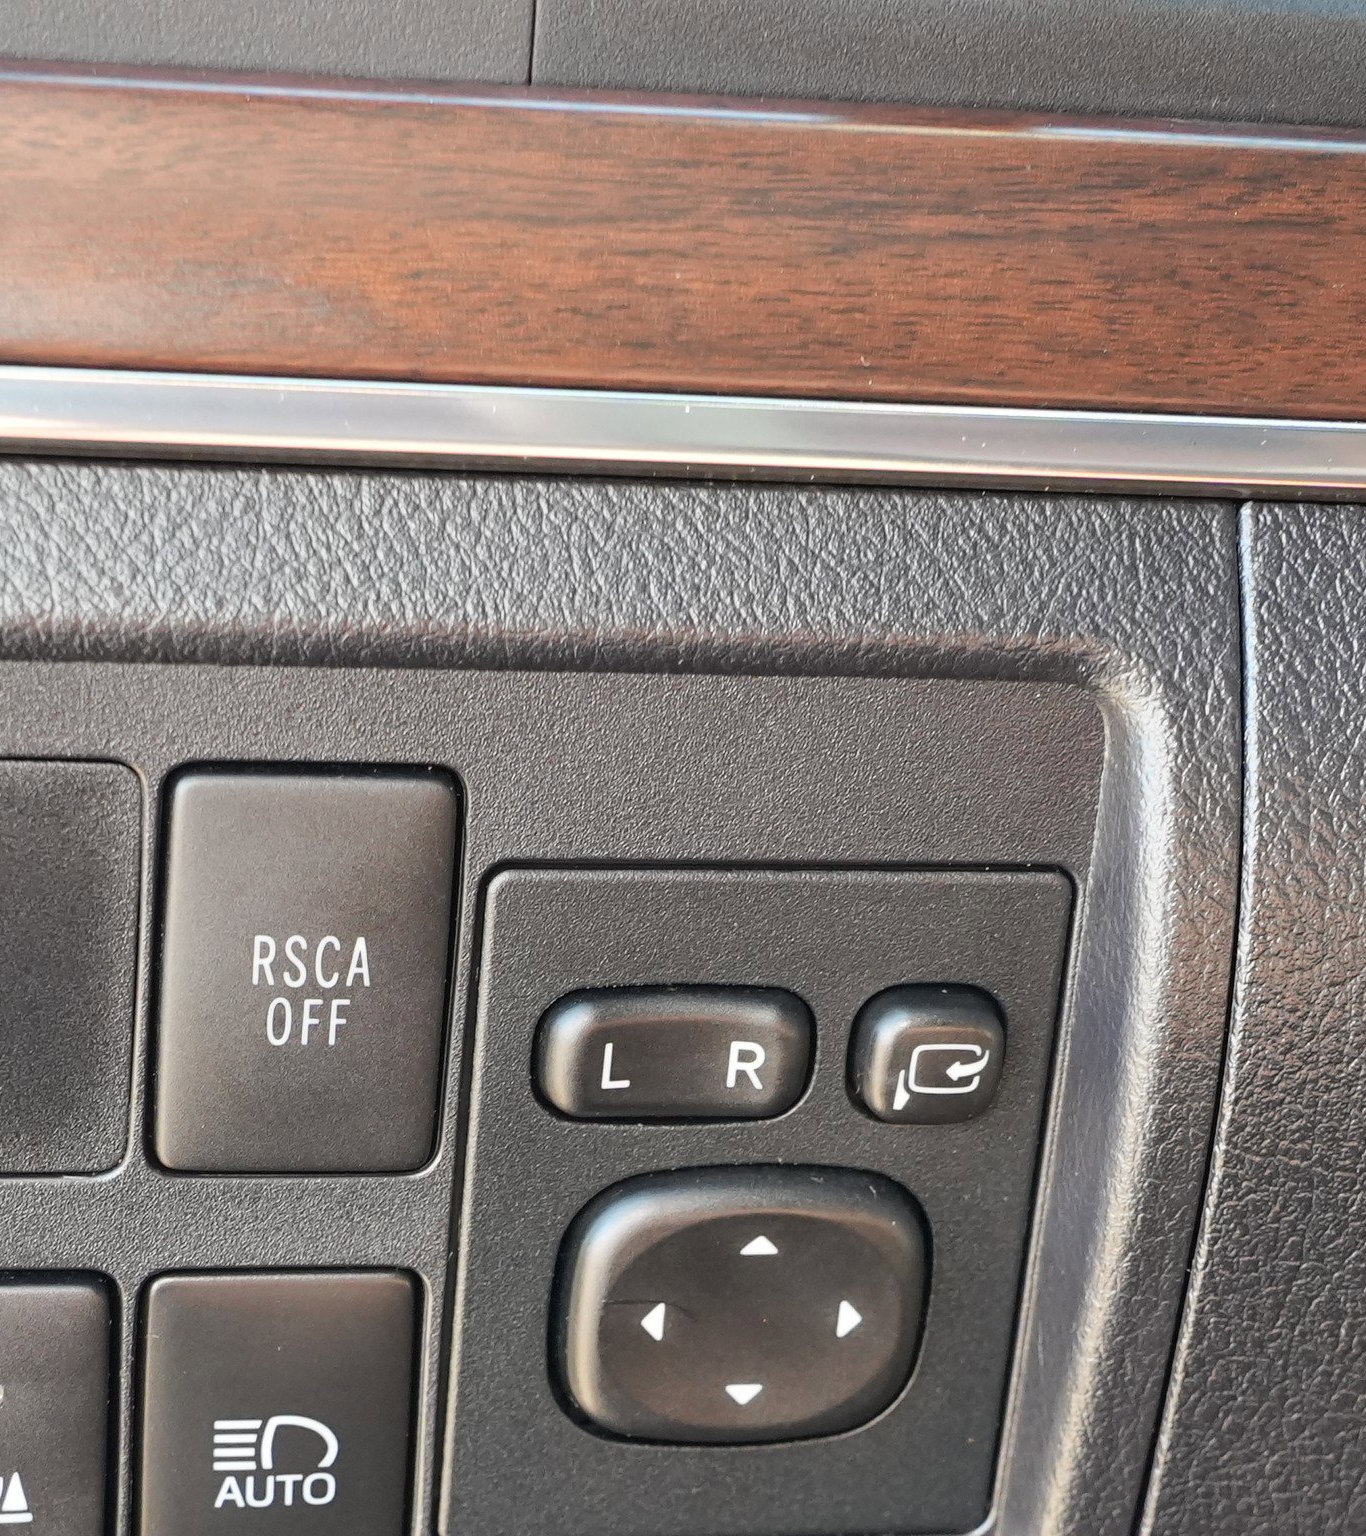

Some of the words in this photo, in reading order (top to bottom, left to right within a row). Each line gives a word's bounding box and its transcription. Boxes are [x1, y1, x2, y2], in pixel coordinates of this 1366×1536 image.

[251, 934, 371, 989] RSCA
[266, 996, 351, 1047] OFF
[600, 1042, 631, 1090] L
[725, 1040, 767, 1091] R
[213, 1472, 337, 1509] AUTO
